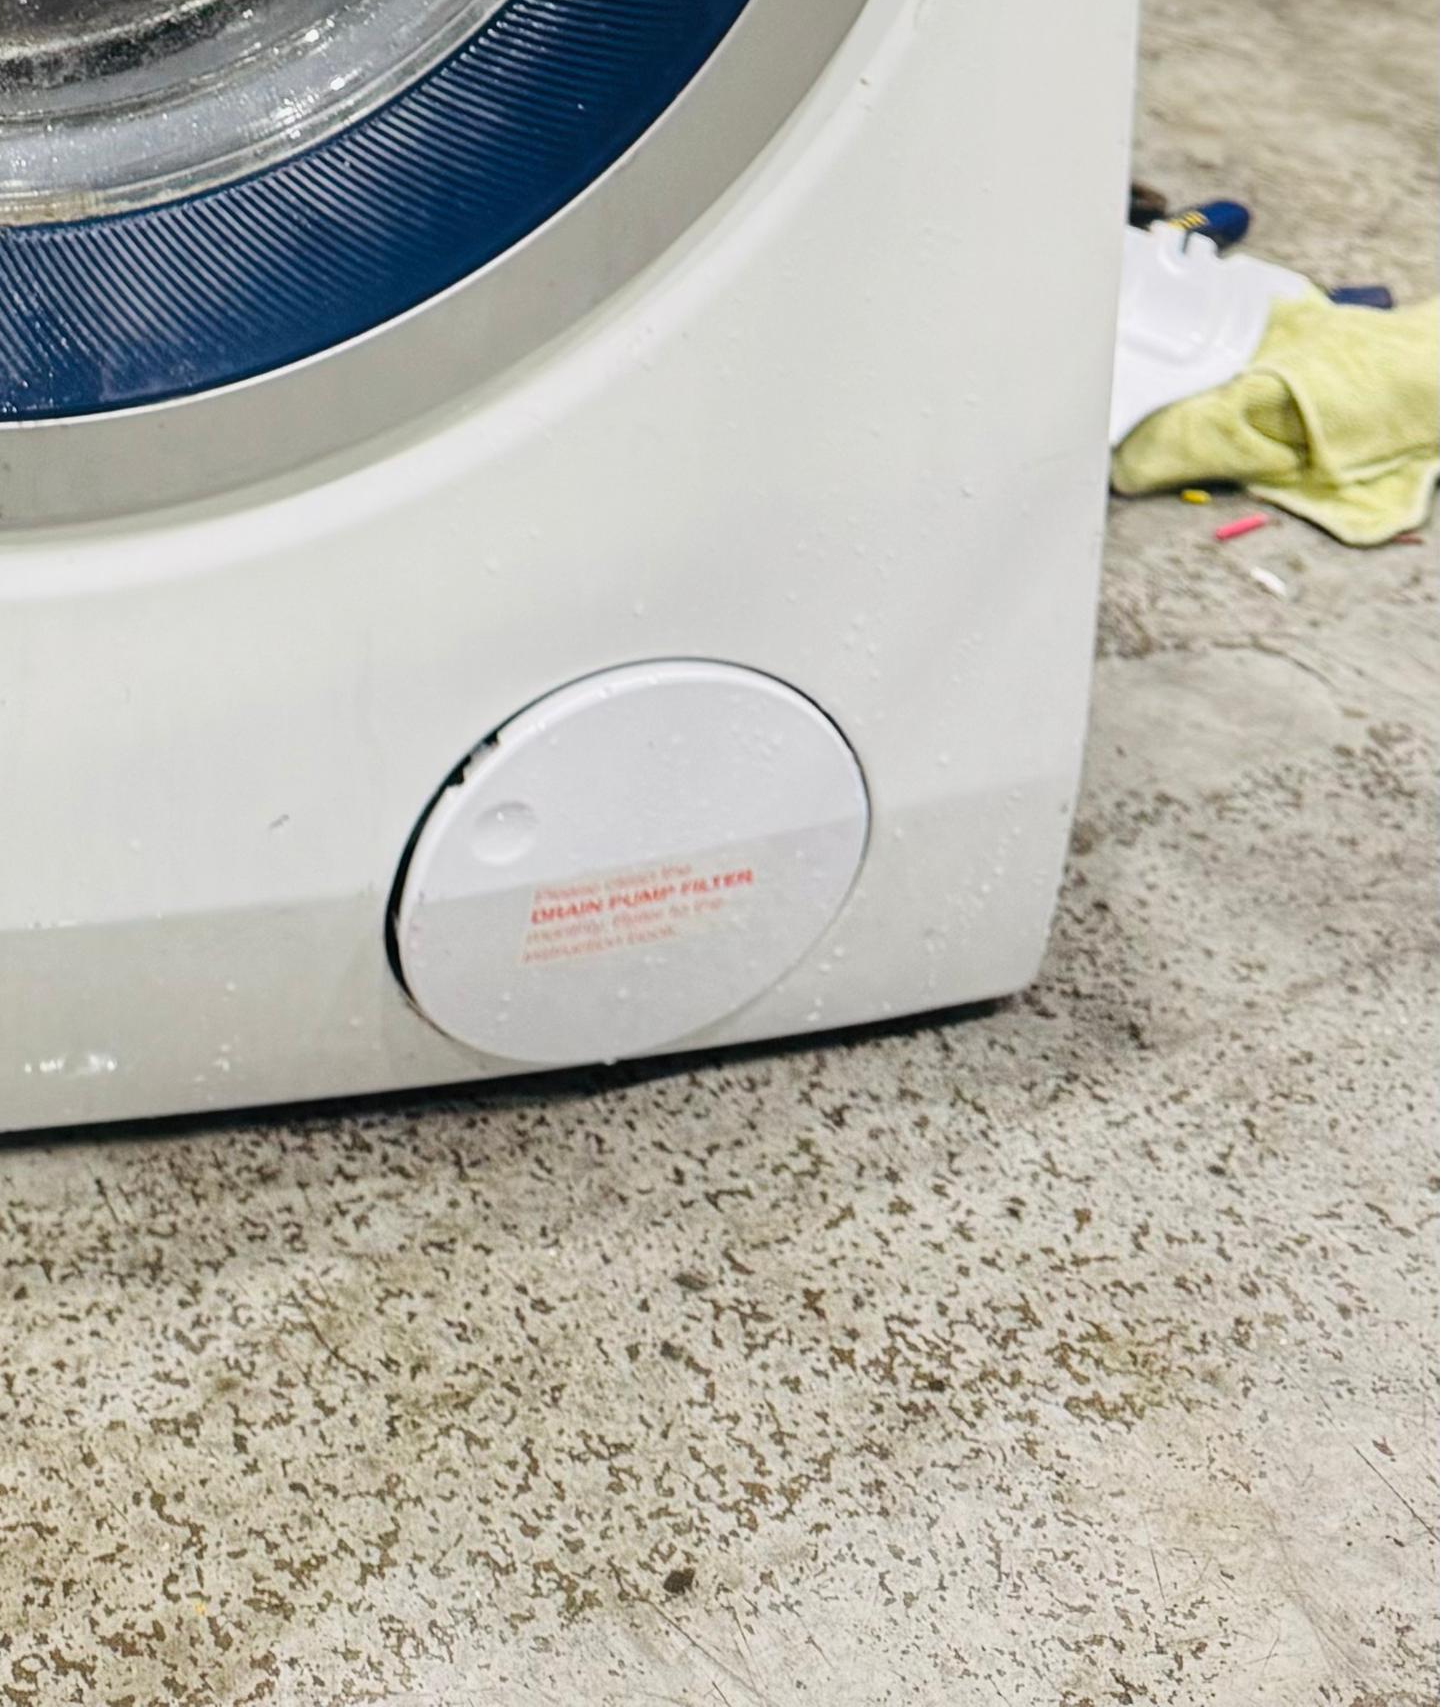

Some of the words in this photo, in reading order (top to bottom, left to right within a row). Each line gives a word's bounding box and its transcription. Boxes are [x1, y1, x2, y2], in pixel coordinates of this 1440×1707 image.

[531, 900, 603, 924] DRAIN
[609, 886, 675, 908] PUMP
[681, 869, 753, 894] FILTER
